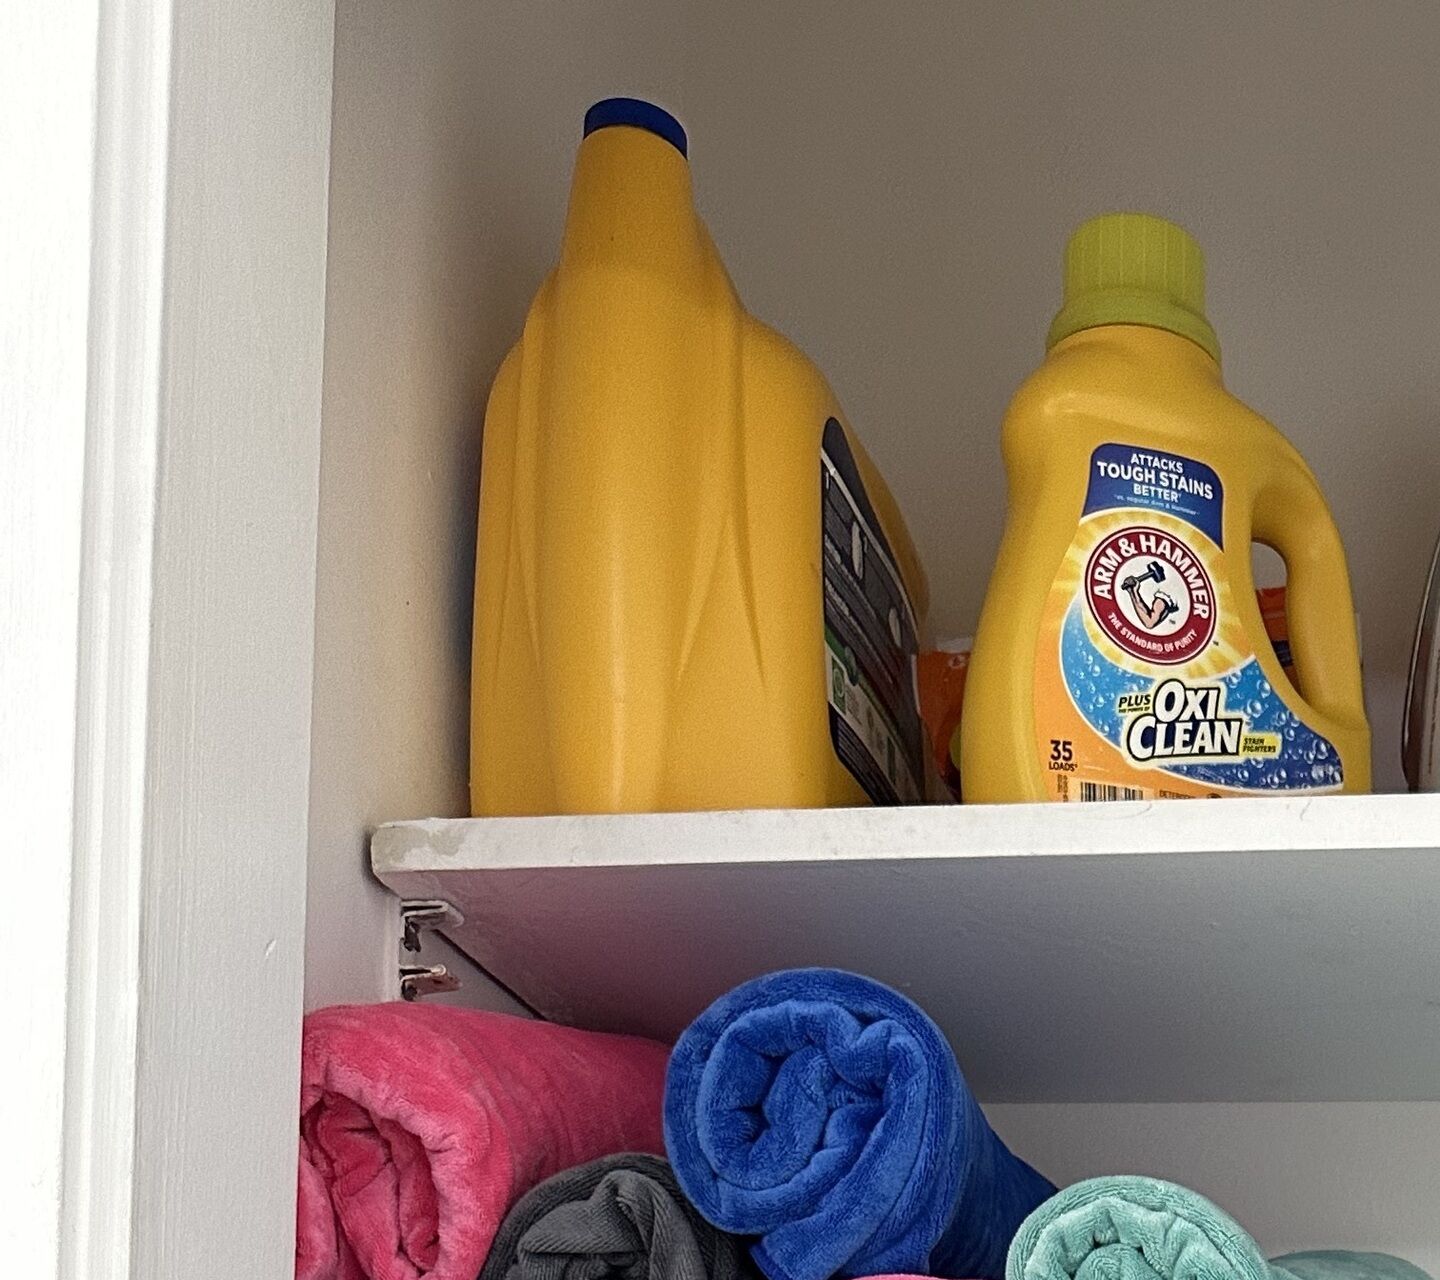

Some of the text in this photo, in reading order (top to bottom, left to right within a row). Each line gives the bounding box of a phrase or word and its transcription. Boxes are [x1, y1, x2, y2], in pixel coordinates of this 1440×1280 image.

[1130, 453, 1184, 474] ATTACKS
[1097, 461, 1213, 500] TOUGH STAINS
[1093, 534, 1209, 619] ARM & HAMMER
[1108, 612, 1198, 652] THE STANDARD OF PURITY
[1118, 695, 1151, 708] PLUS
[1154, 679, 1220, 723] OXI
[1050, 739, 1073, 762] 35
[1128, 714, 1242, 761] CLEAN
[1242, 745, 1276, 754] FIGHTERS
[1243, 737, 1265, 746] STAIN
